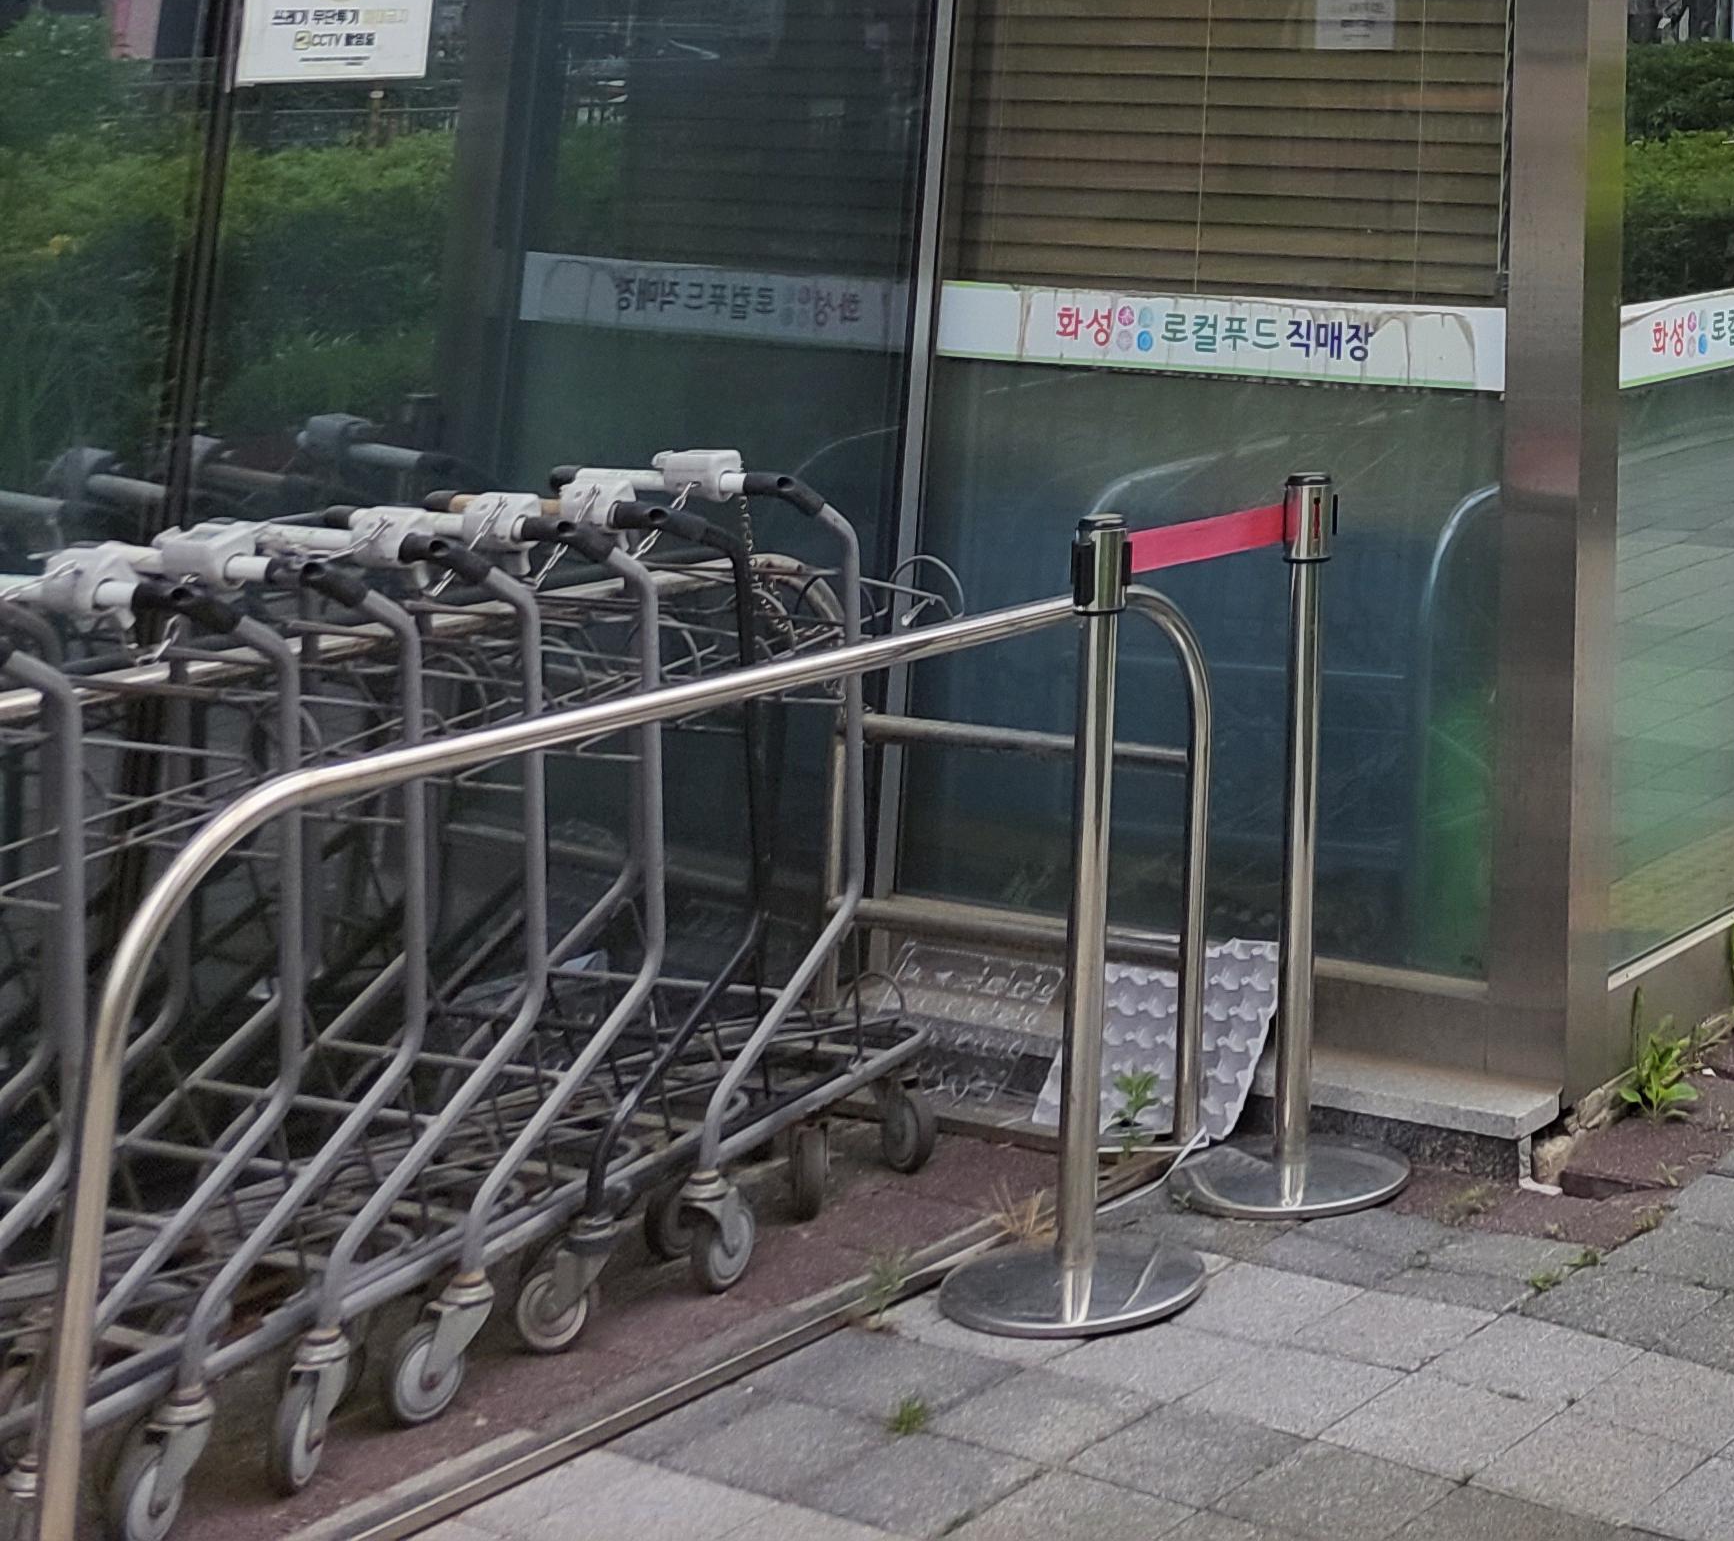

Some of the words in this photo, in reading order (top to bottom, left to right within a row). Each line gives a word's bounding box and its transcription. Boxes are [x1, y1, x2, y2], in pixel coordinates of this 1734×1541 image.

[311, 33, 343, 47] CCTV
[1055, 305, 1114, 347] 화성
[1161, 313, 1281, 352] 로컬푸드
[1285, 319, 1375, 363] 직매장
[1651, 316, 1685, 357] 화성
